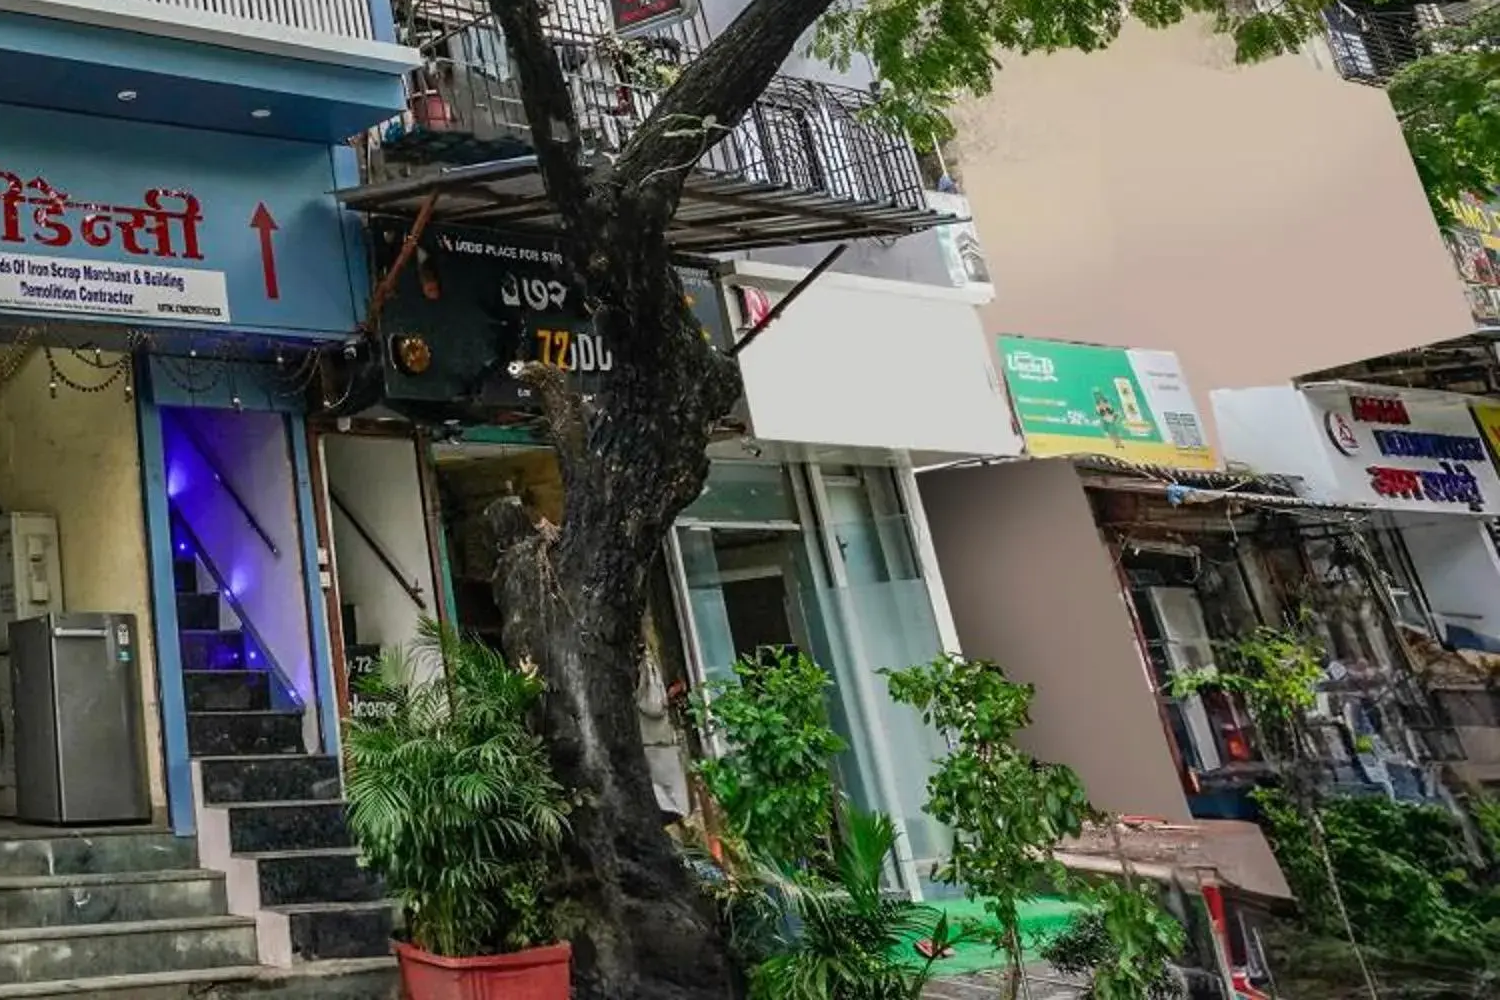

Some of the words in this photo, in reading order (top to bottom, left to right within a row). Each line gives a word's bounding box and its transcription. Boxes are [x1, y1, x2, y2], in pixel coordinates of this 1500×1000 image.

[13, 258, 25, 274] Of
[27, 260, 48, 277] Iron
[50, 262, 81, 282] Scrap
[133, 269, 141, 285] &
[143, 269, 185, 292] Building
